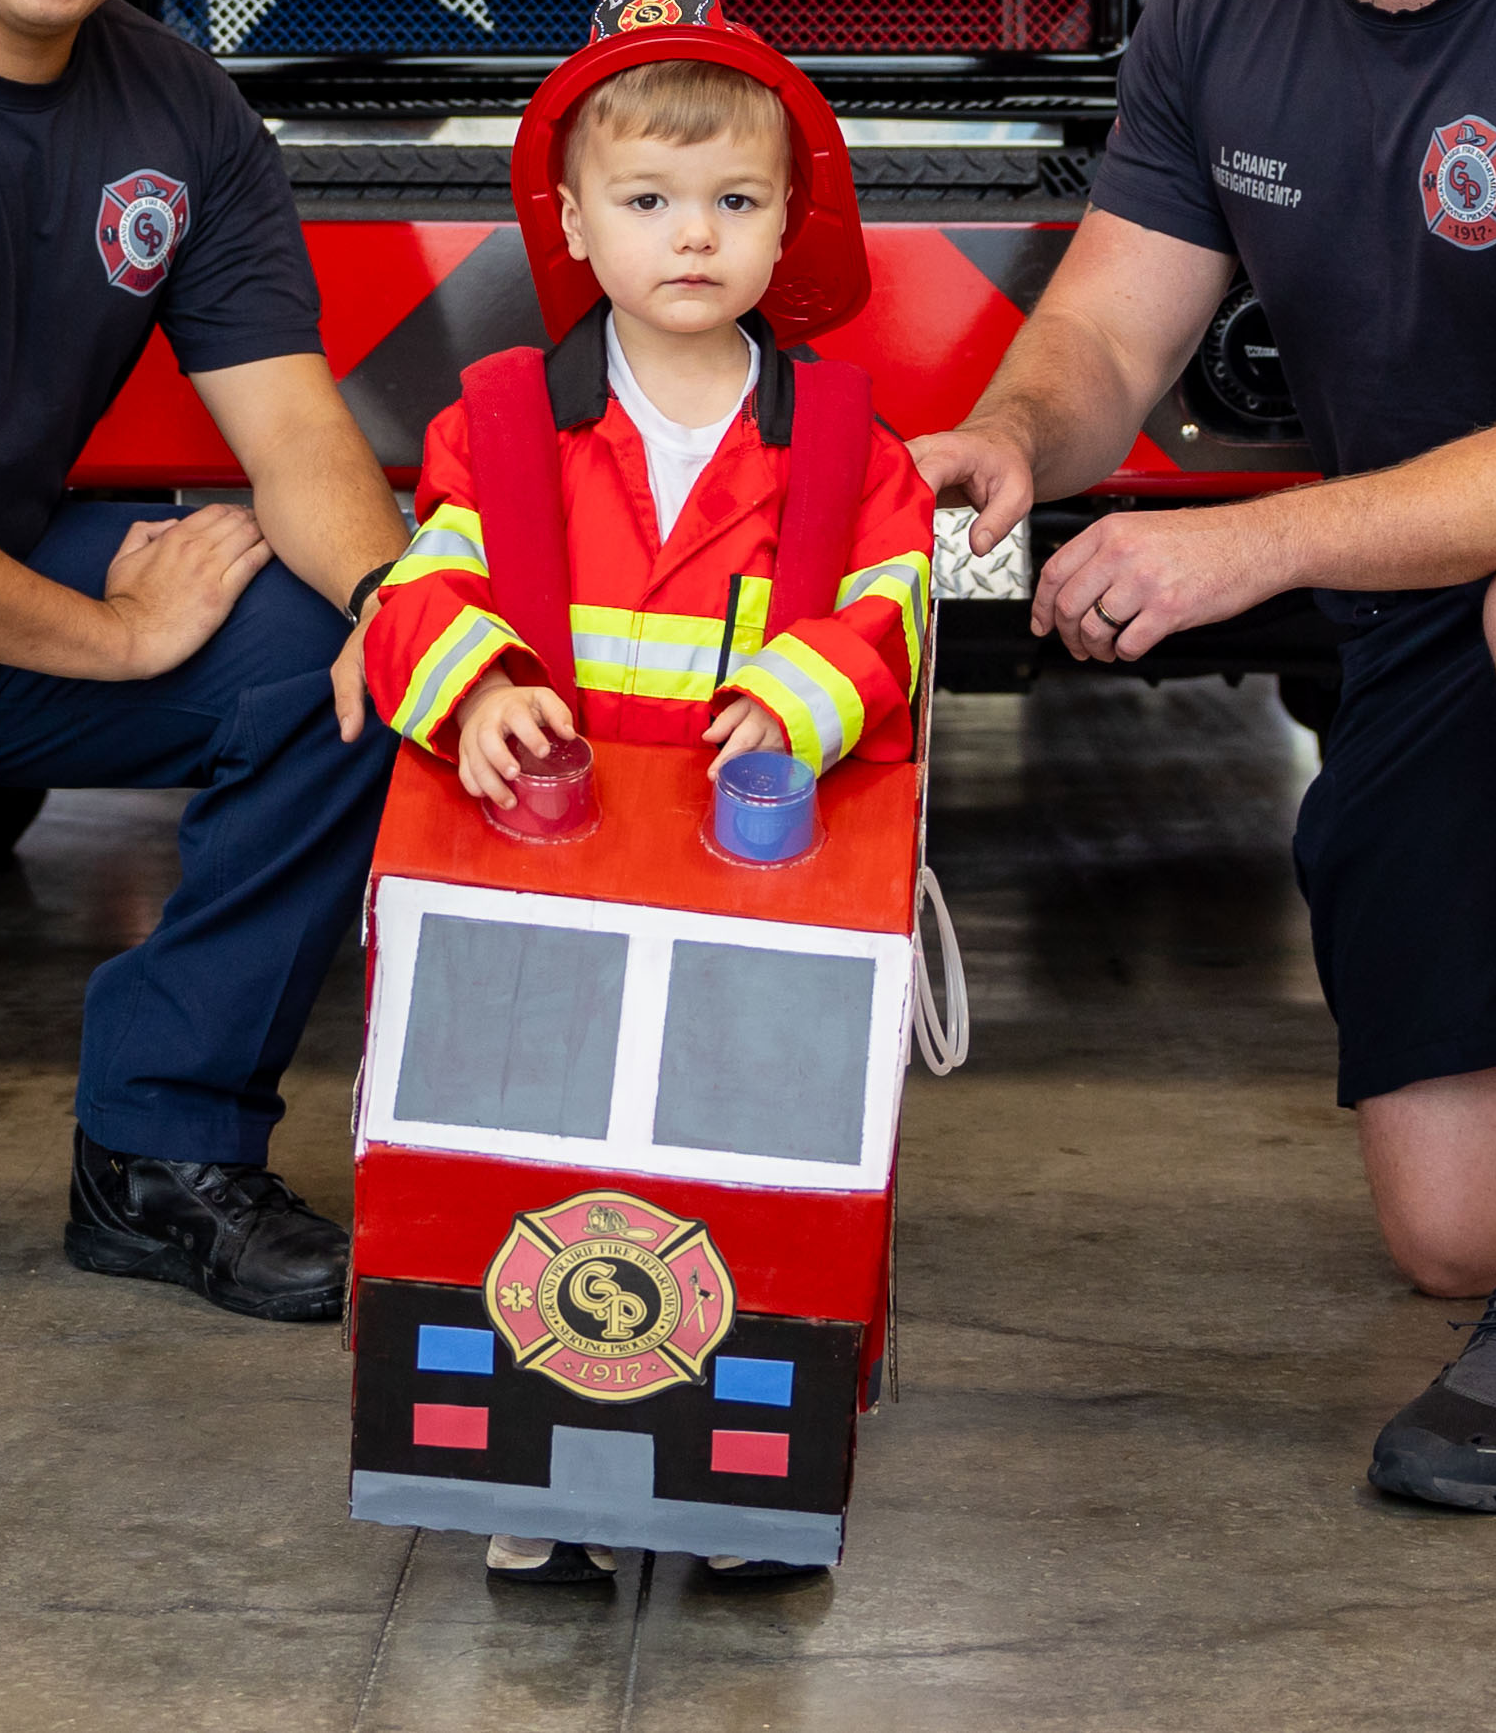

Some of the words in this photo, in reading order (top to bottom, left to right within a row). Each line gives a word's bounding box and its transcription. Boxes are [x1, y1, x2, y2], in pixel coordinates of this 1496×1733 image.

[1221, 146, 1230, 167] L.
[1233, 150, 1287, 181] CHANEY
[1453, 225, 1486, 241] 1917
[543, 1277, 558, 1319] GRAND
[552, 1245, 598, 1278] PRAIRIE
[600, 1244, 633, 1258] FIRE
[634, 1252, 675, 1324] DEPARTMENT
[558, 1325, 606, 1353] SERVING
[610, 1331, 662, 1353] PROUDLY
[575, 1362, 642, 1384] 1917
